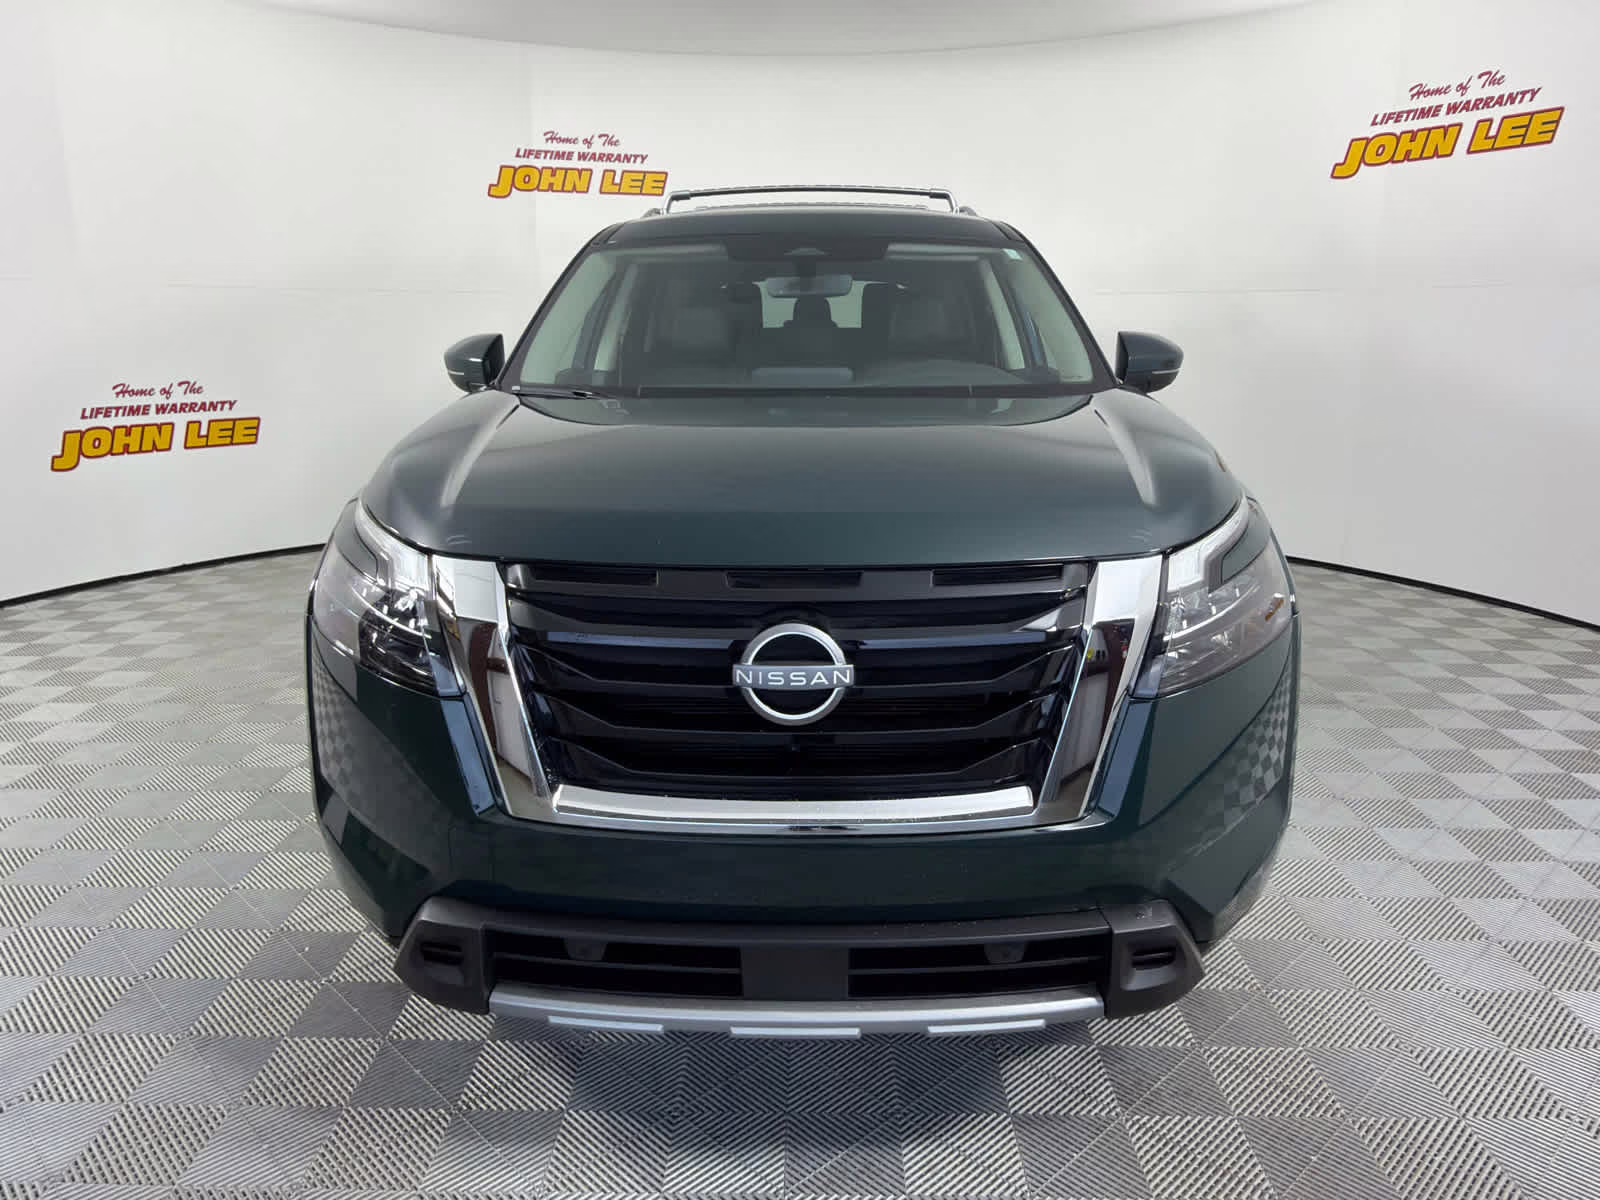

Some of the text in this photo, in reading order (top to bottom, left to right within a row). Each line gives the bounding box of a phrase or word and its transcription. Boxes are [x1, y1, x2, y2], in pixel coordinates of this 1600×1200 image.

[1409, 69, 1506, 101] Home of The
[1370, 87, 1542, 127] LIFETIME WARRANTY
[543, 131, 620, 149] Home of The
[1330, 106, 1565, 179] JOHN LEE
[515, 148, 648, 164] LIFETIME WARRANTY
[488, 164, 668, 199] JOHN LEE
[112, 380, 204, 400] Home of The
[80, 399, 237, 420] LIFETIME WARRANTY
[50, 416, 261, 472] JOHN LEE
[736, 669, 850, 686] NISSAN
